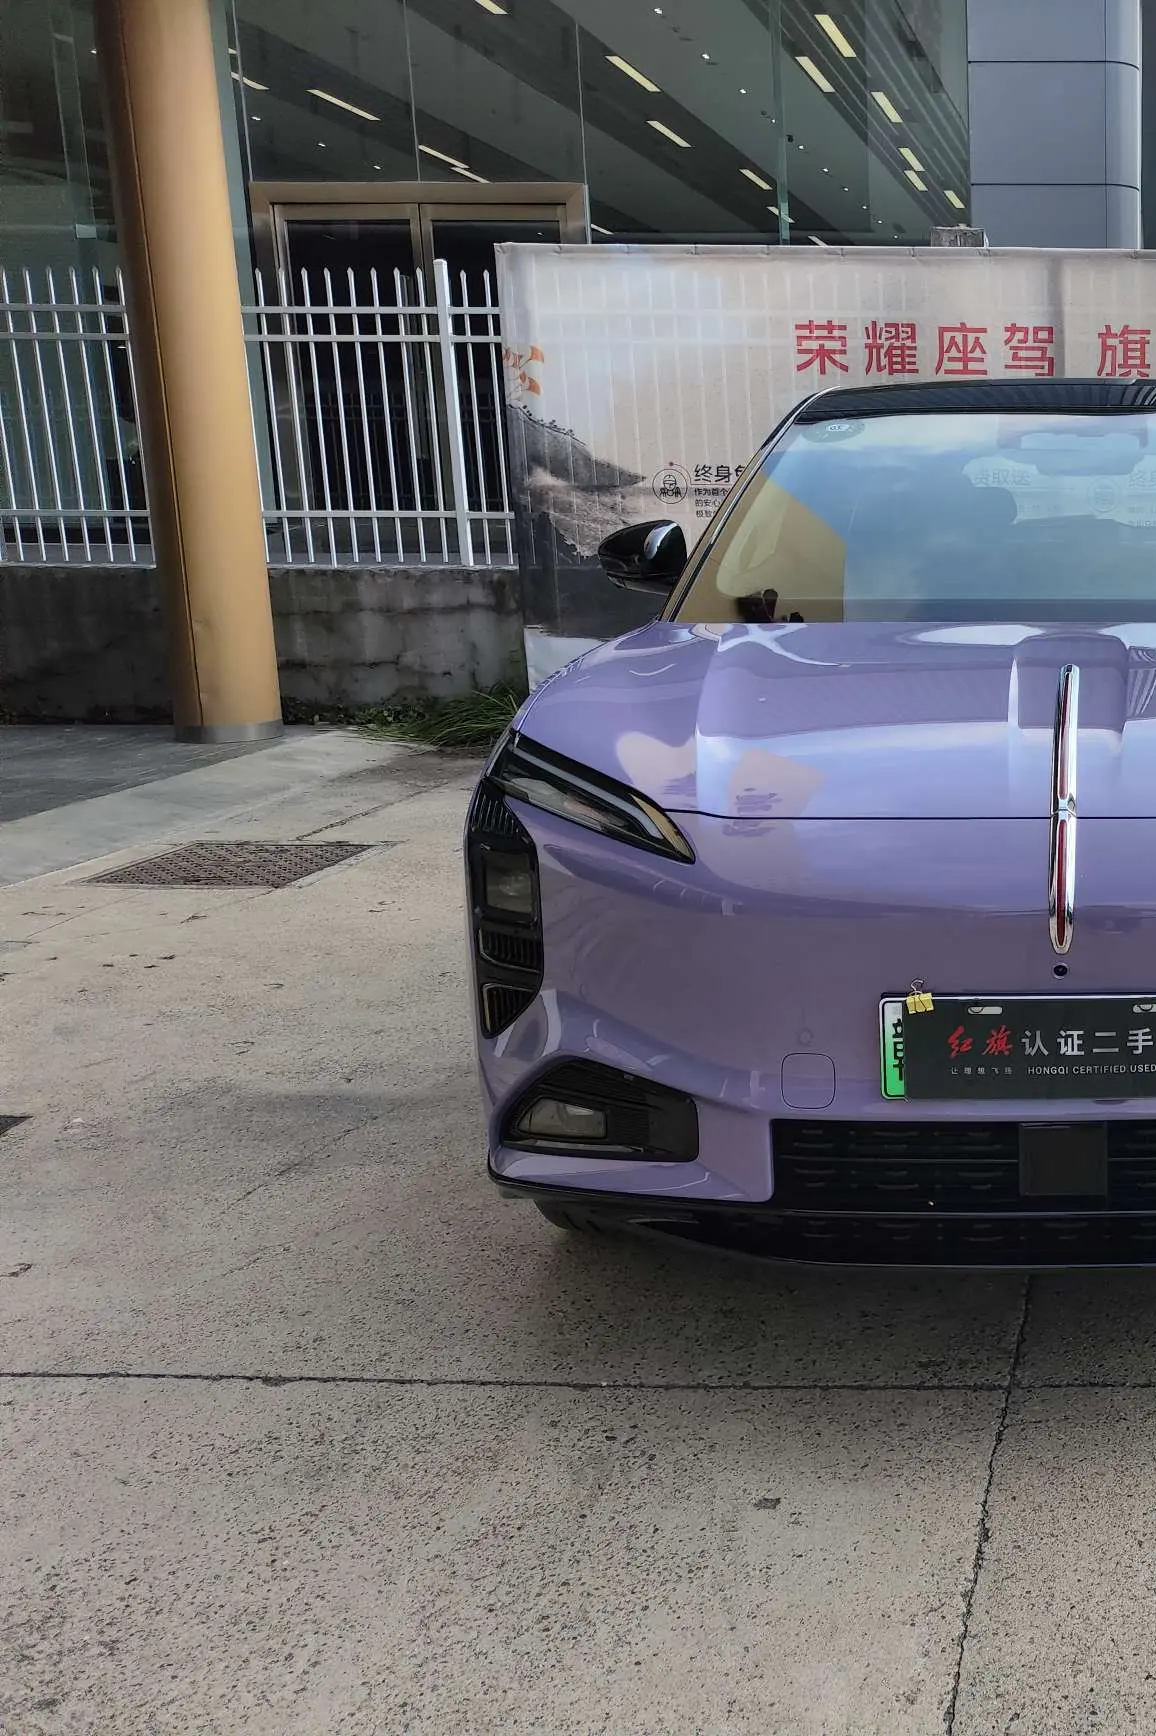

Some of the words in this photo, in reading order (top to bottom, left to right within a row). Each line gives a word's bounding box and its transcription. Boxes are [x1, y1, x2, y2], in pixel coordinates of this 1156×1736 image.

[795, 320, 1056, 377] 荣耀座驾
[1027, 1066, 1069, 1075] HONGQI
[1072, 1065, 1126, 1075] CERTIFIED
[1130, 1064, 1156, 1073] USED
